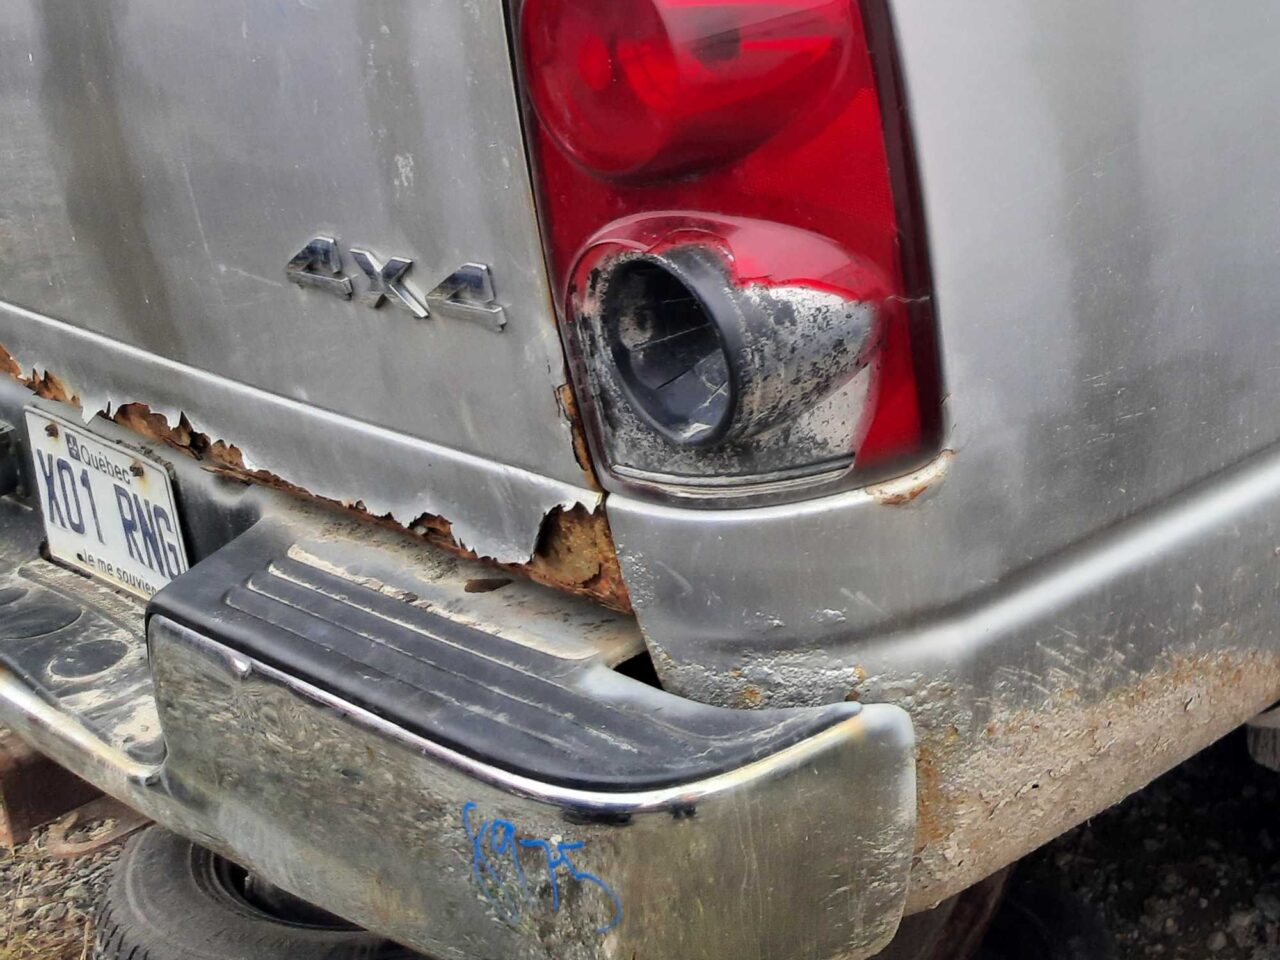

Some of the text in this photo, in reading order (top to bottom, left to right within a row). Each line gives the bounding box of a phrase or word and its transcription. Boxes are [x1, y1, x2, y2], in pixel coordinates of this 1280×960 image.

[79, 443, 131, 485] Québec
[112, 483, 188, 580] RNG
[97, 558, 114, 576] me
[116, 567, 157, 596] souvien
